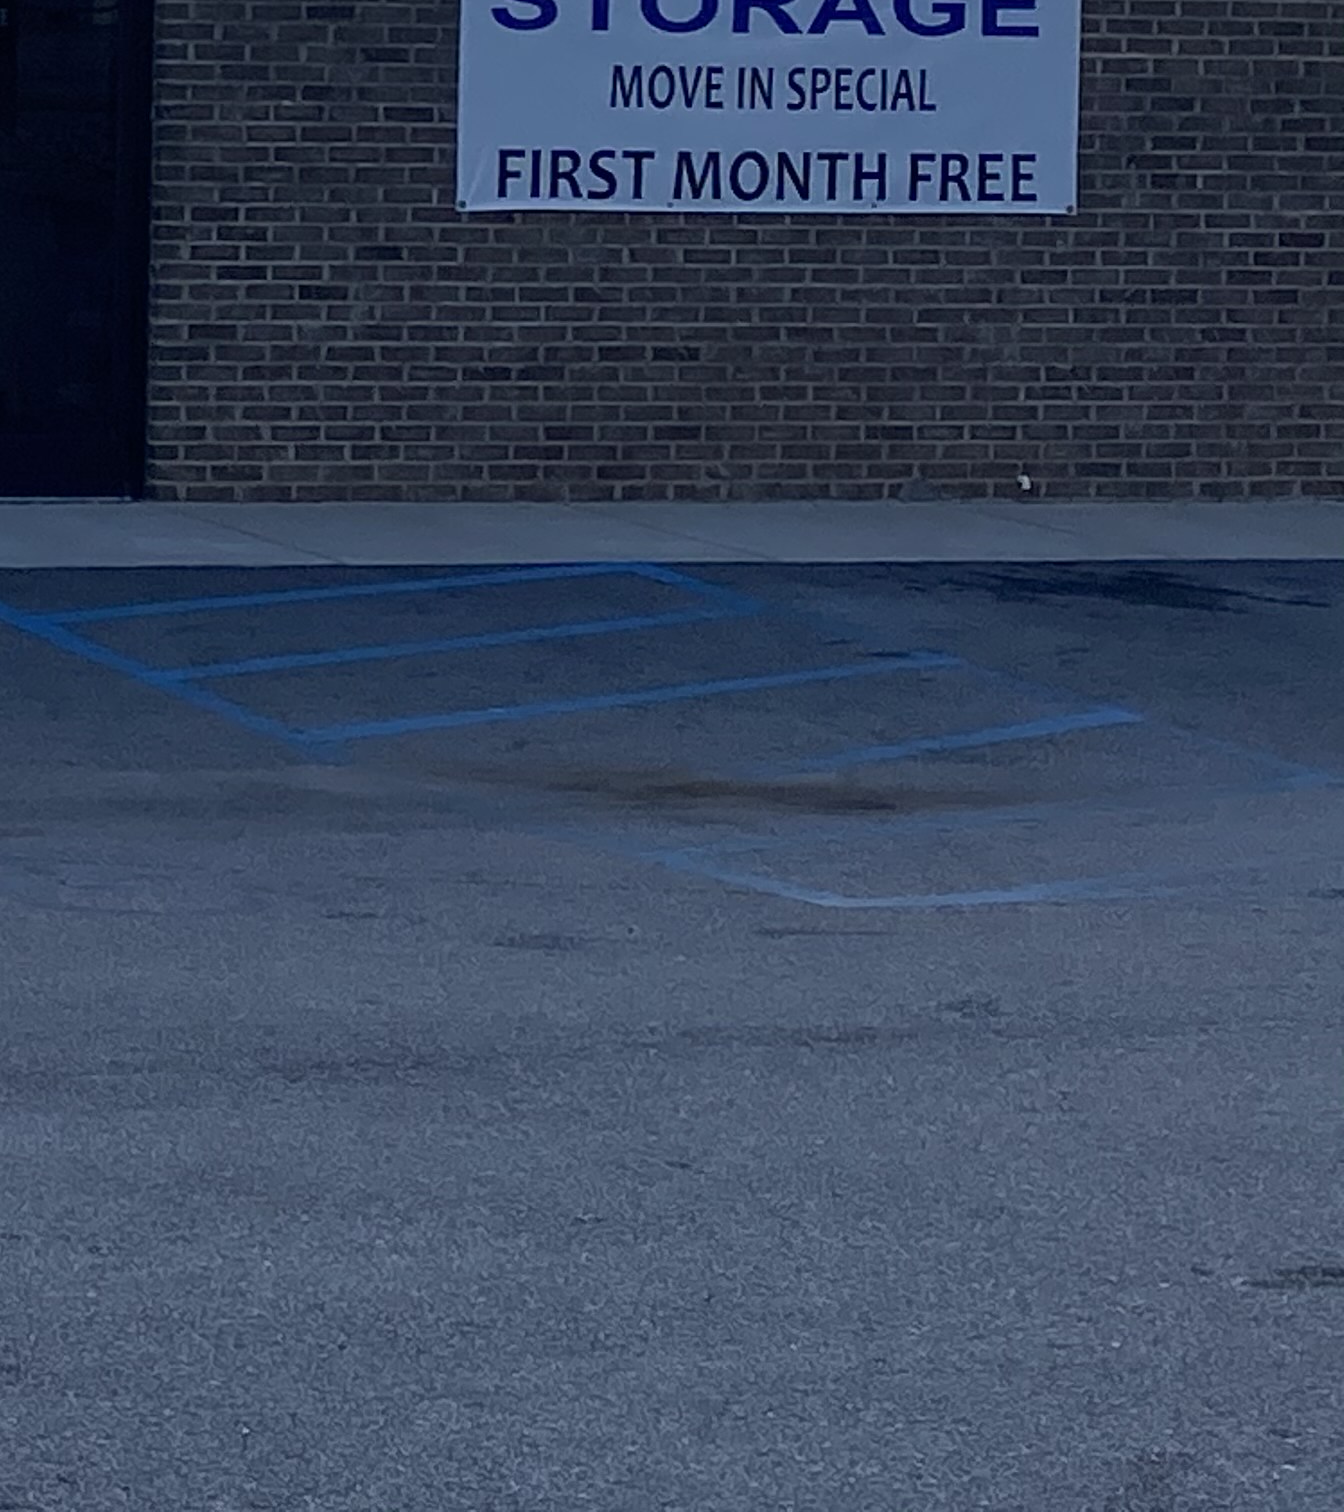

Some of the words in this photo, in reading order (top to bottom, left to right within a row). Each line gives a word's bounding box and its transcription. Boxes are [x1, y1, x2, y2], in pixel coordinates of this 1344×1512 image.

[609, 64, 724, 109] MOVE
[737, 66, 775, 110] IN
[786, 67, 937, 112] SPECIAL
[497, 149, 656, 201] FIRST
[672, 150, 887, 201] MONTH
[908, 152, 1038, 202] FREE
